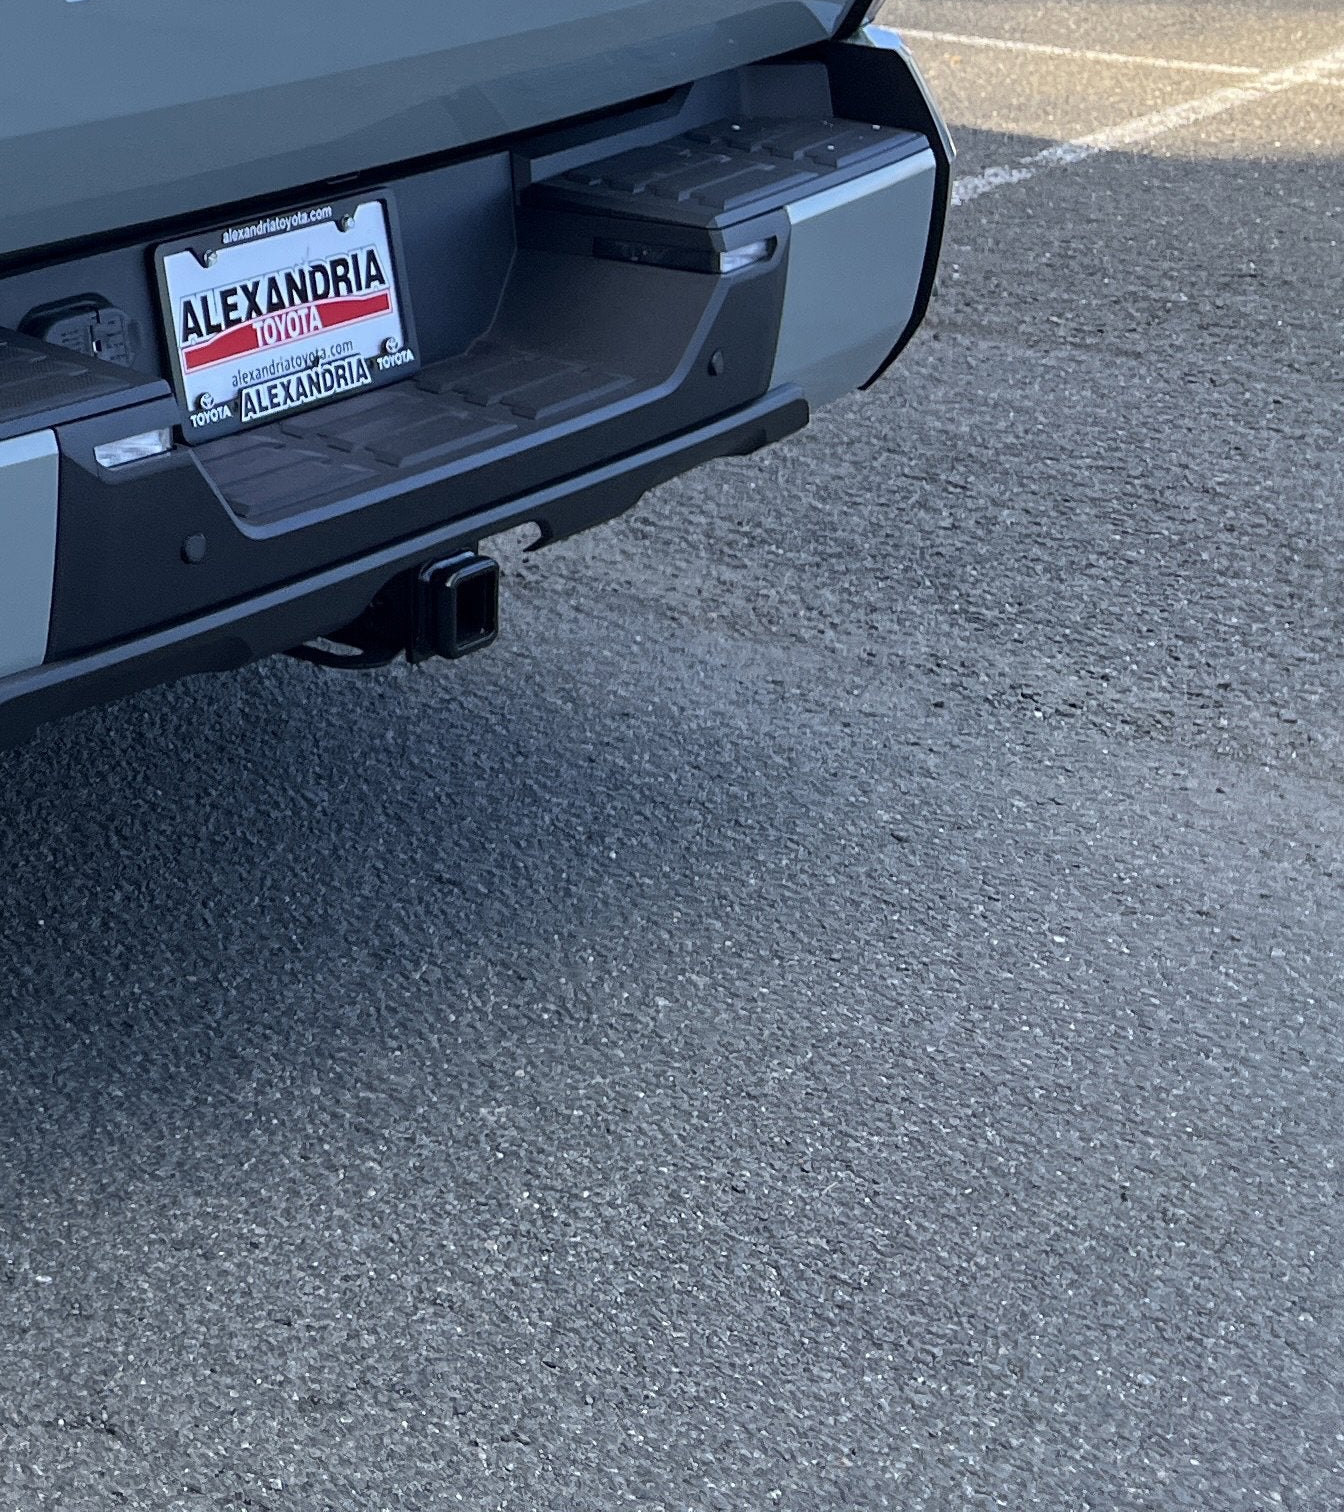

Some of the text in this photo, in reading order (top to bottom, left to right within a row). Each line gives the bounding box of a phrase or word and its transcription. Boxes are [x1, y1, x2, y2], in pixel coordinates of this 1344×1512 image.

[222, 205, 333, 245] alexandriatoyota.com
[181, 248, 386, 343] ALEXANDRIA
[252, 306, 324, 348] TOYOTA
[232, 339, 354, 388] alexandriatoyota.com
[377, 349, 415, 370] TOYOTA
[242, 356, 370, 422] ALEXANDRIA
[190, 407, 233, 428] TOYOTA
